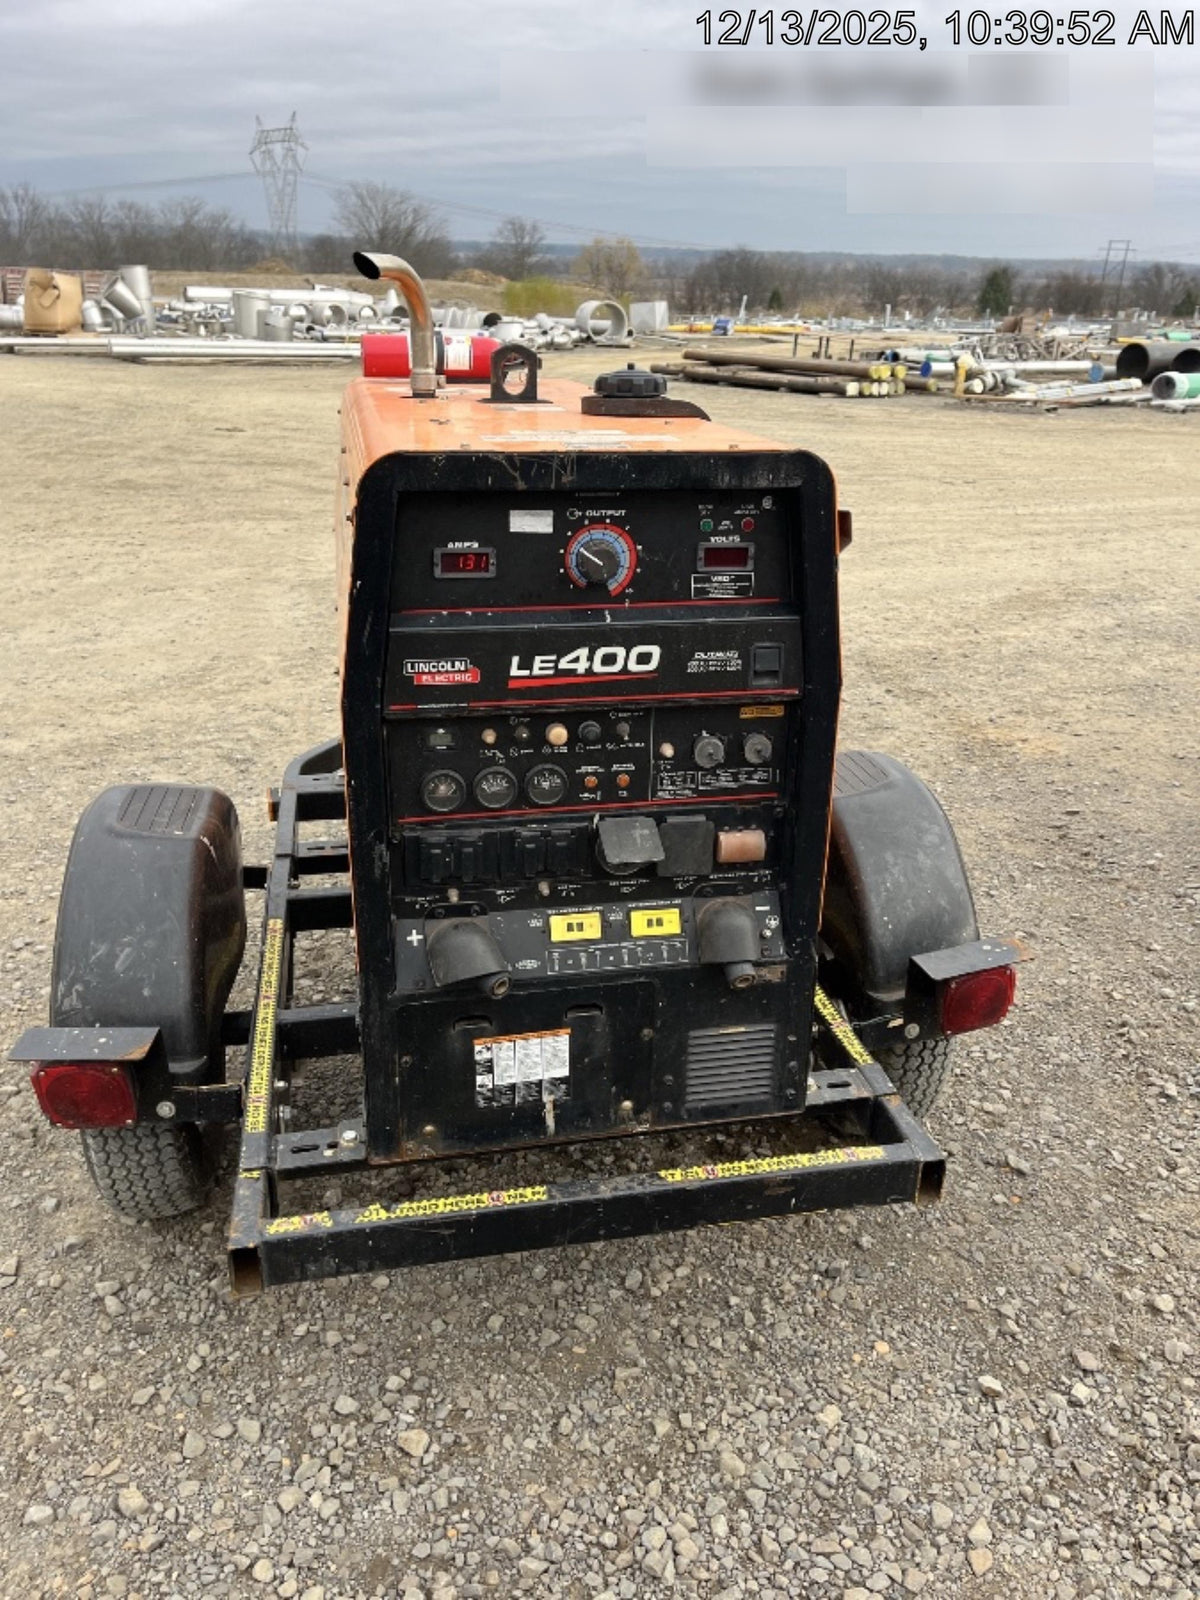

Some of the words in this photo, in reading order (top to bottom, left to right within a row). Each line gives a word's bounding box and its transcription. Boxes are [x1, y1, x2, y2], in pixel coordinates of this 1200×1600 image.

[709, 535, 740, 543] VOLTS
[447, 541, 479, 549] AMPS
[460, 553, 486, 570] 131
[509, 645, 662, 676] LE400
[407, 660, 466, 673] LINCOLN
[422, 673, 473, 682] ELECTRIC
